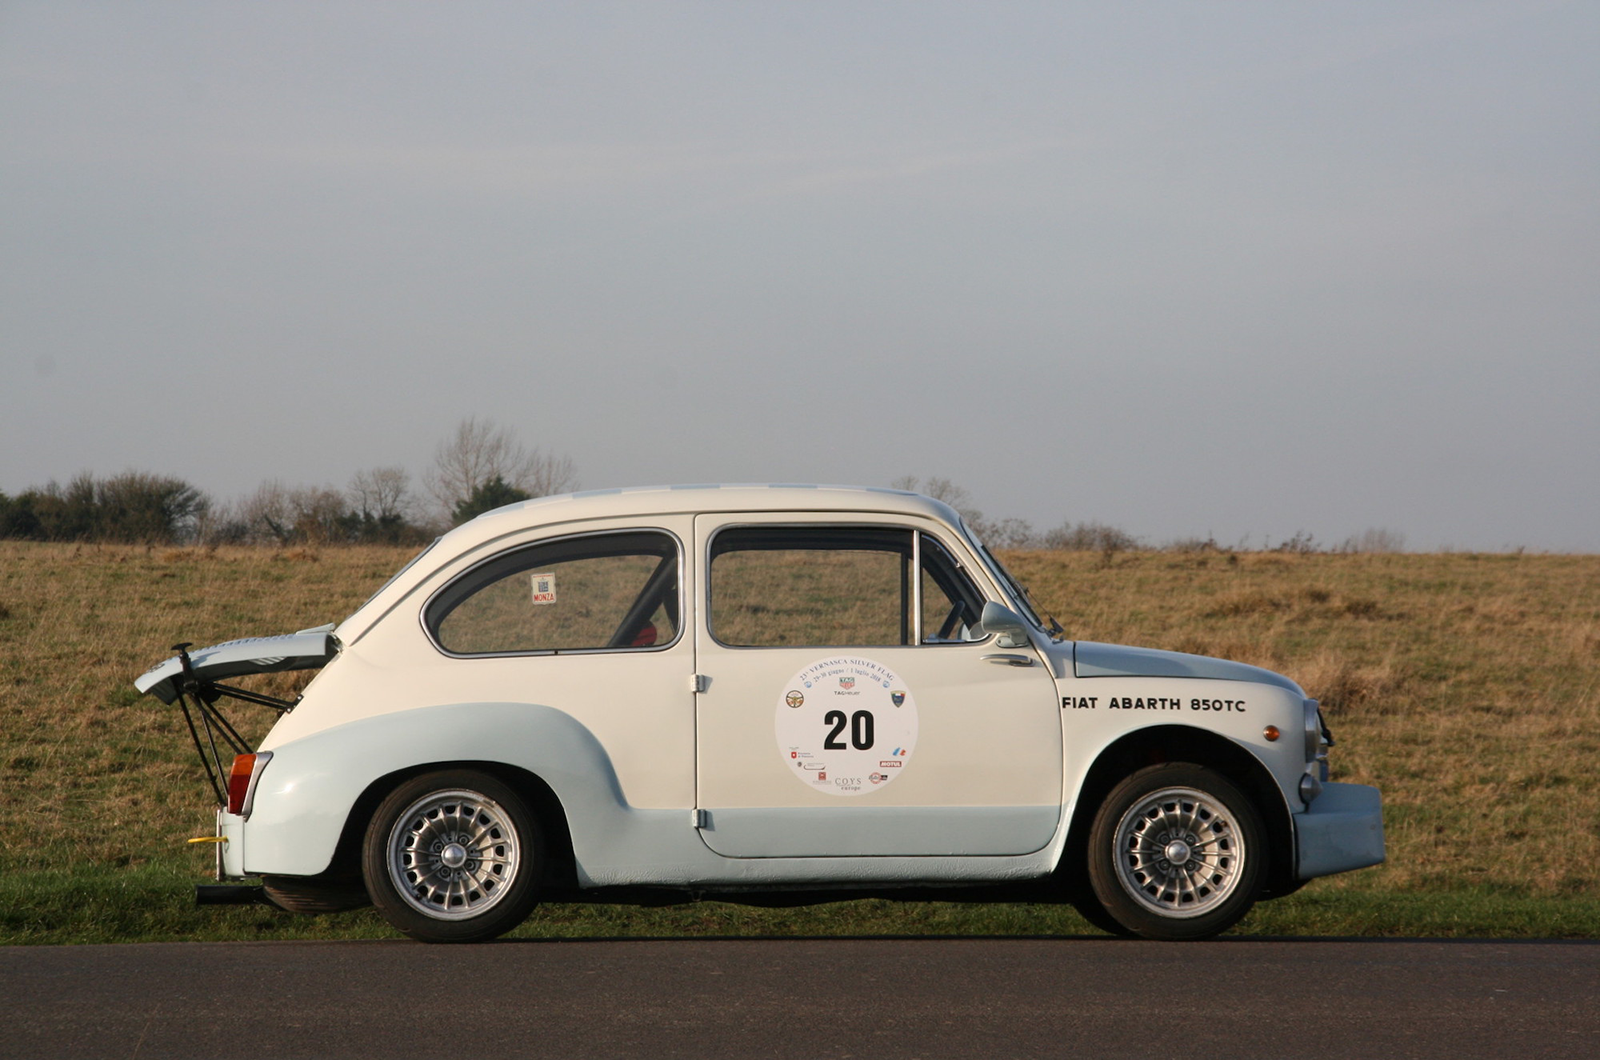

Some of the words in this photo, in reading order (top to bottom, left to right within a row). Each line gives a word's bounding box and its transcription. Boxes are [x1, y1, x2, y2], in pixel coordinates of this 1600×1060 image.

[534, 593, 554, 602] MONZA
[809, 659, 848, 673] VERNASCA
[850, 659, 877, 670] SILVER
[877, 666, 895, 681] FLAG
[828, 668, 845, 677] giugno
[854, 668, 870, 677] luglio
[1062, 697, 1098, 709] FIAT
[1109, 697, 1181, 710] ABARTH
[1191, 698, 1246, 712] 850TC
[824, 710, 874, 751] 20
[834, 777, 862, 786] COYS
